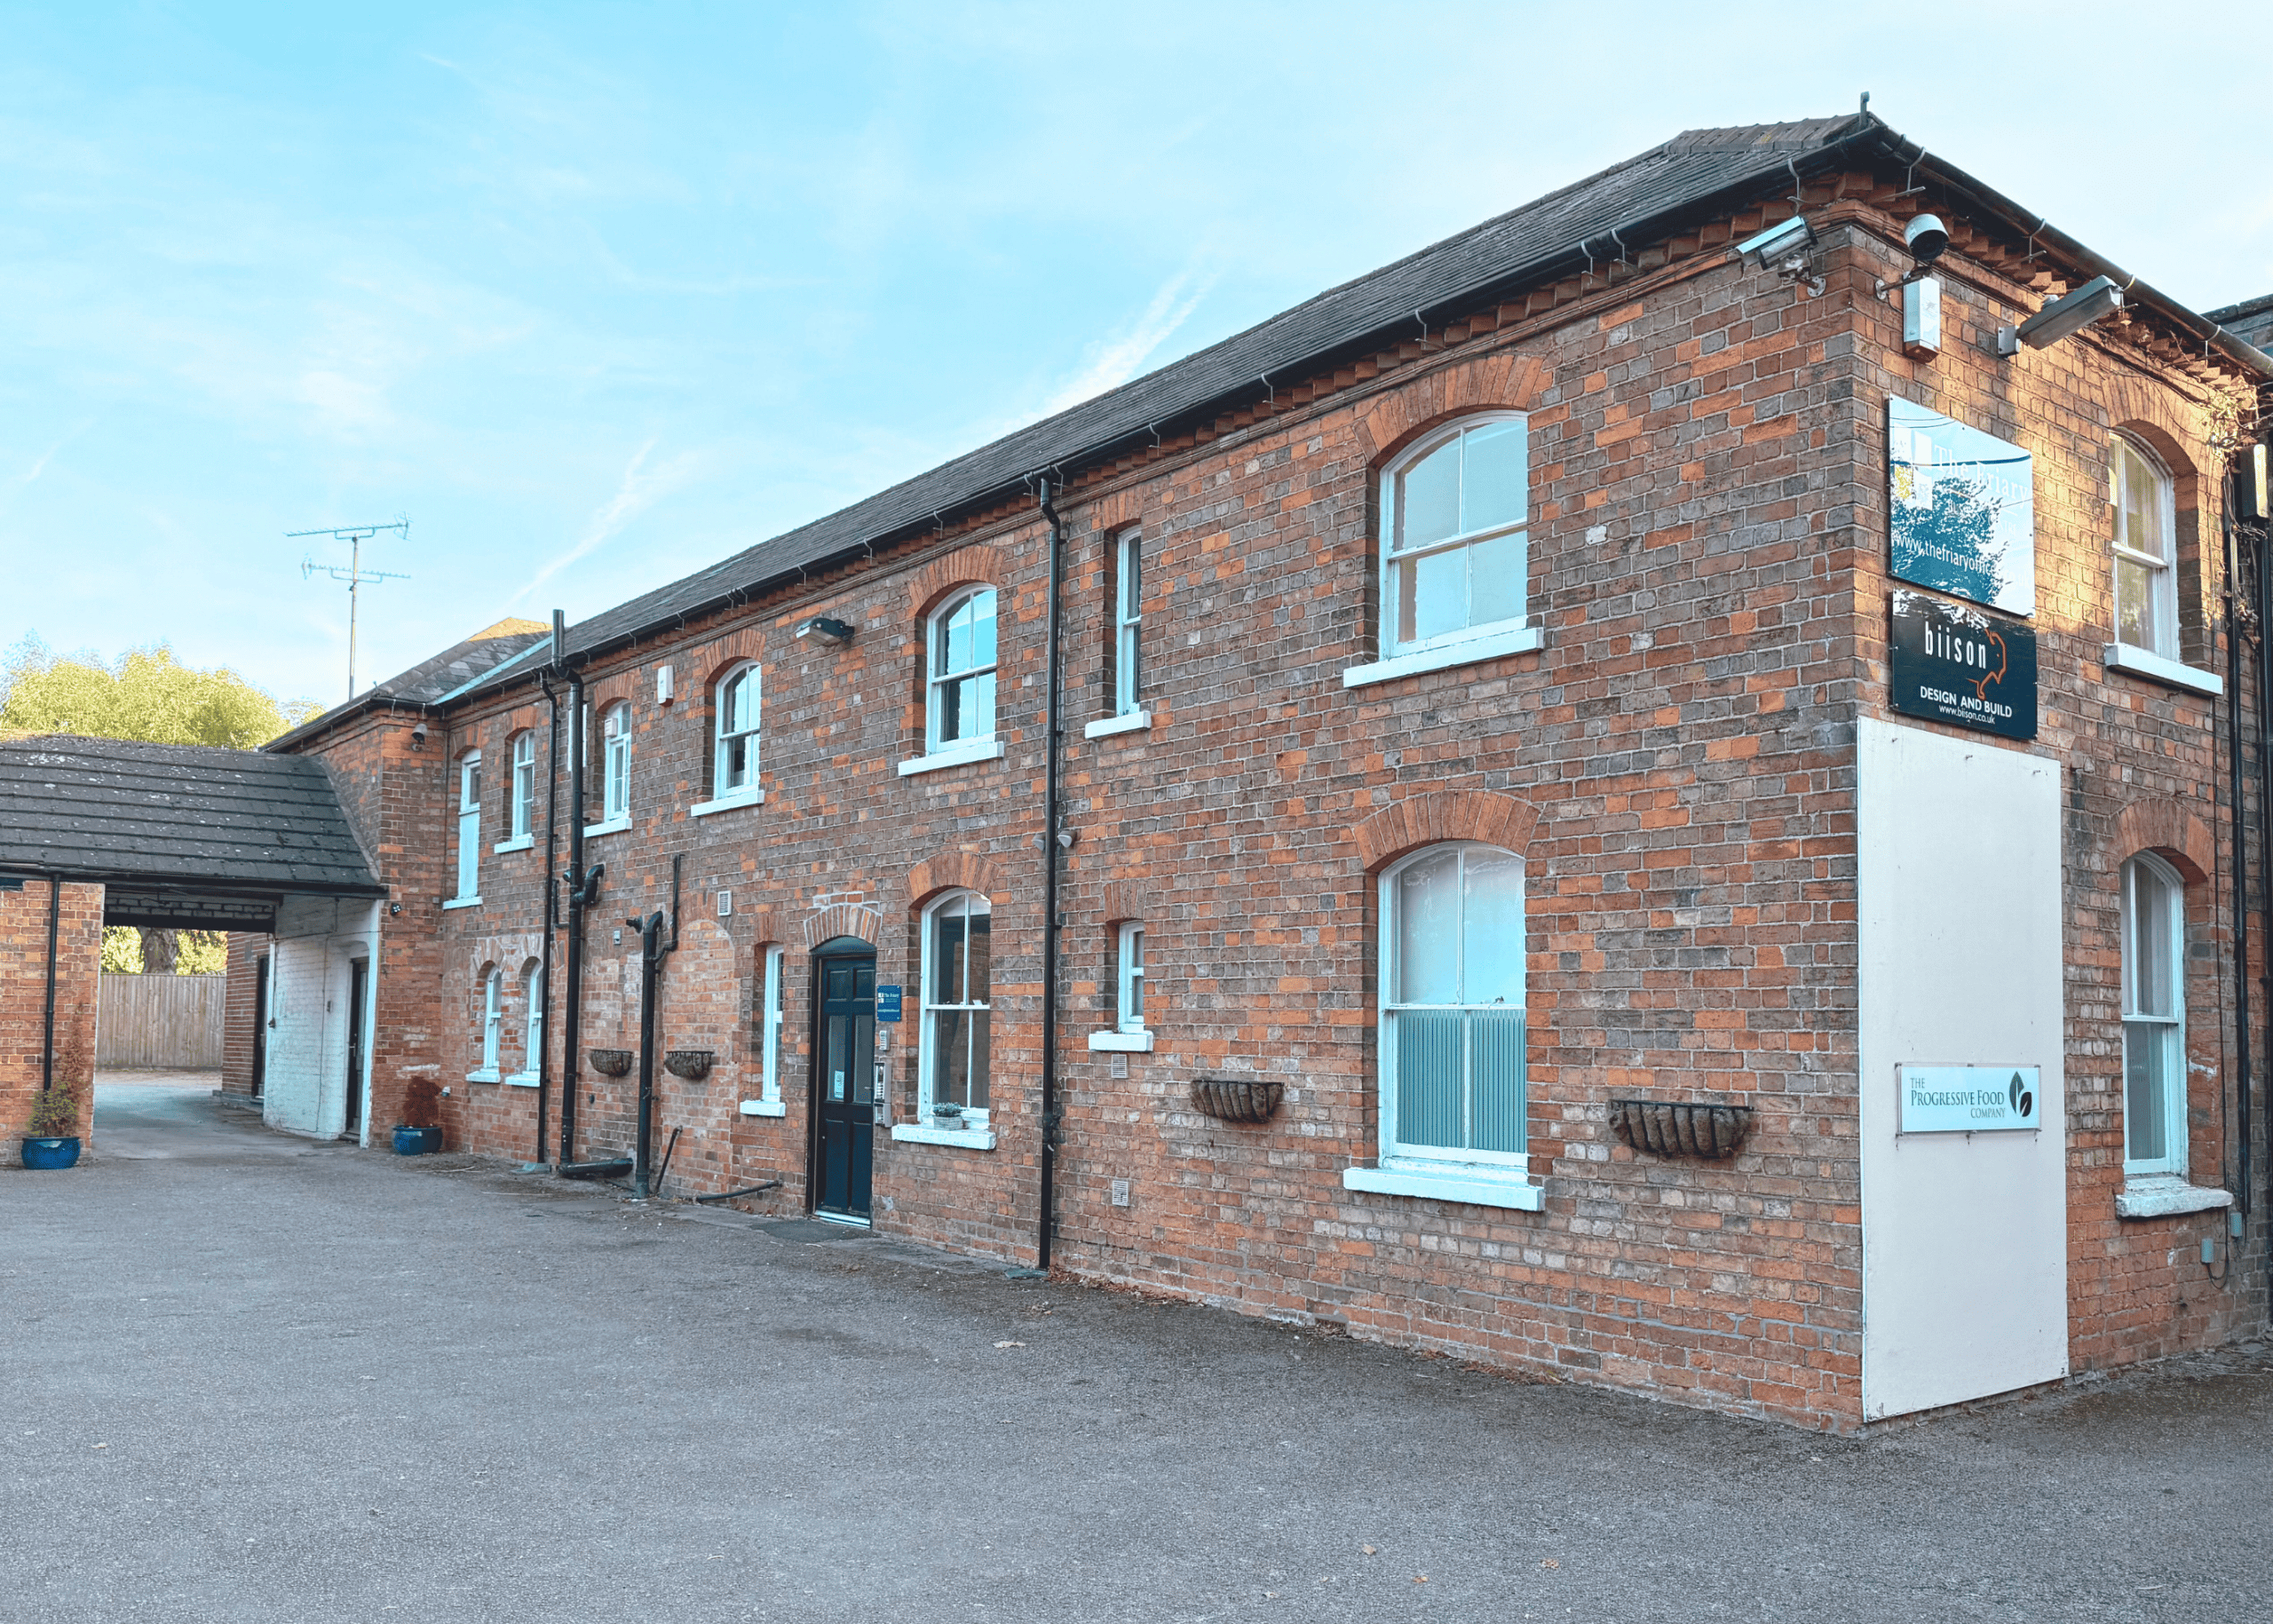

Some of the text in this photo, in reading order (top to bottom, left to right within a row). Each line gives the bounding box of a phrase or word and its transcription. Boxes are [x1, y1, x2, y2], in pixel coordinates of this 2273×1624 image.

[1934, 444, 2028, 509] The Friary
[1925, 621, 1986, 669] biison
[1920, 685, 2012, 717] DESIGN AND BUILD
[1938, 704, 1995, 725] www.biison.co.uk
[1910, 1077, 1925, 1089] THE
[1911, 1089, 2005, 1106] PROGRESSIVE FOOD
[1970, 1107, 2006, 1119] COMPANY
